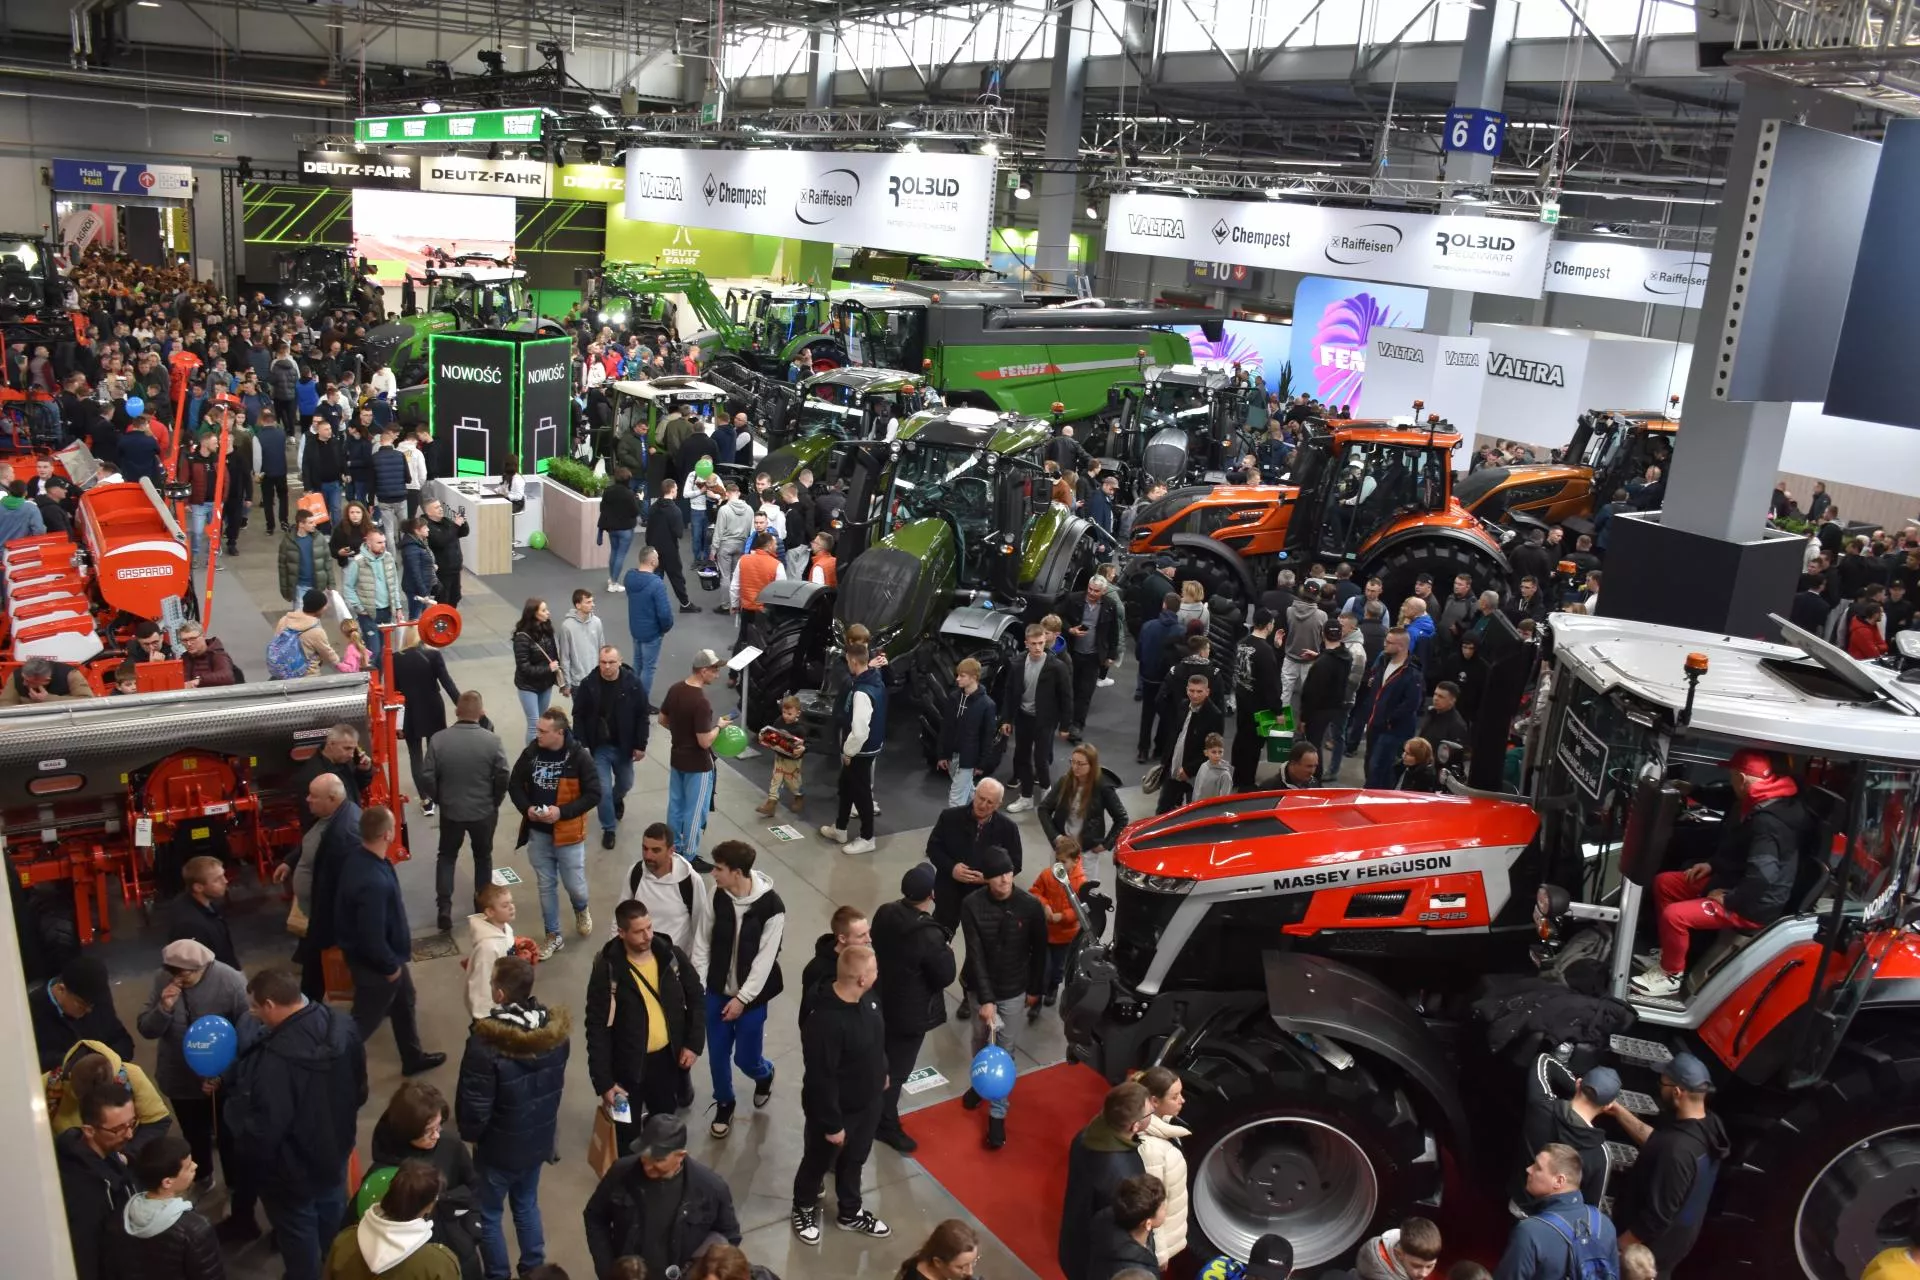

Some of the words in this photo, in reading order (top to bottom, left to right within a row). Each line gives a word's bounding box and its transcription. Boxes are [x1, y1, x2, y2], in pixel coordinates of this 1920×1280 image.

[1452, 120, 1469, 147] 6
[1483, 123, 1497, 151] 6
[79, 167, 102, 177] Hala
[107, 165, 127, 191] 7
[303, 161, 411, 179] DEUTZ-FAHR
[431, 168, 541, 185] DEUTZ-FAHR
[83, 176, 102, 186] Hall
[640, 172, 682, 201] VALTRA
[719, 182, 767, 209] Chempest
[808, 189, 852, 207] Raiffeisen
[889, 175, 960, 207] ROLBUD
[1128, 214, 1185, 239] VALTRA
[1232, 226, 1290, 249] Chempest
[1341, 237, 1393, 254] Raiffeisen
[1436, 232, 1515, 256] ROLBUD
[662, 248, 700, 258] DEUTZ
[665, 257, 697, 265] FAHR
[1212, 263, 1230, 280] 10
[1553, 261, 1611, 280] Chempest
[1378, 342, 1424, 363] VALTRA
[1445, 351, 1479, 366] VALTRA
[441, 364, 502, 384] NOWOŚĆ
[528, 362, 565, 384] NOWOŚĆ
[999, 363, 1048, 378] FENDT
[1487, 352, 1564, 387] VALTRA
[118, 566, 172, 579] GASPARDO
[1274, 869, 1350, 890] MASSEY
[1356, 856, 1451, 879] FERGUSON
